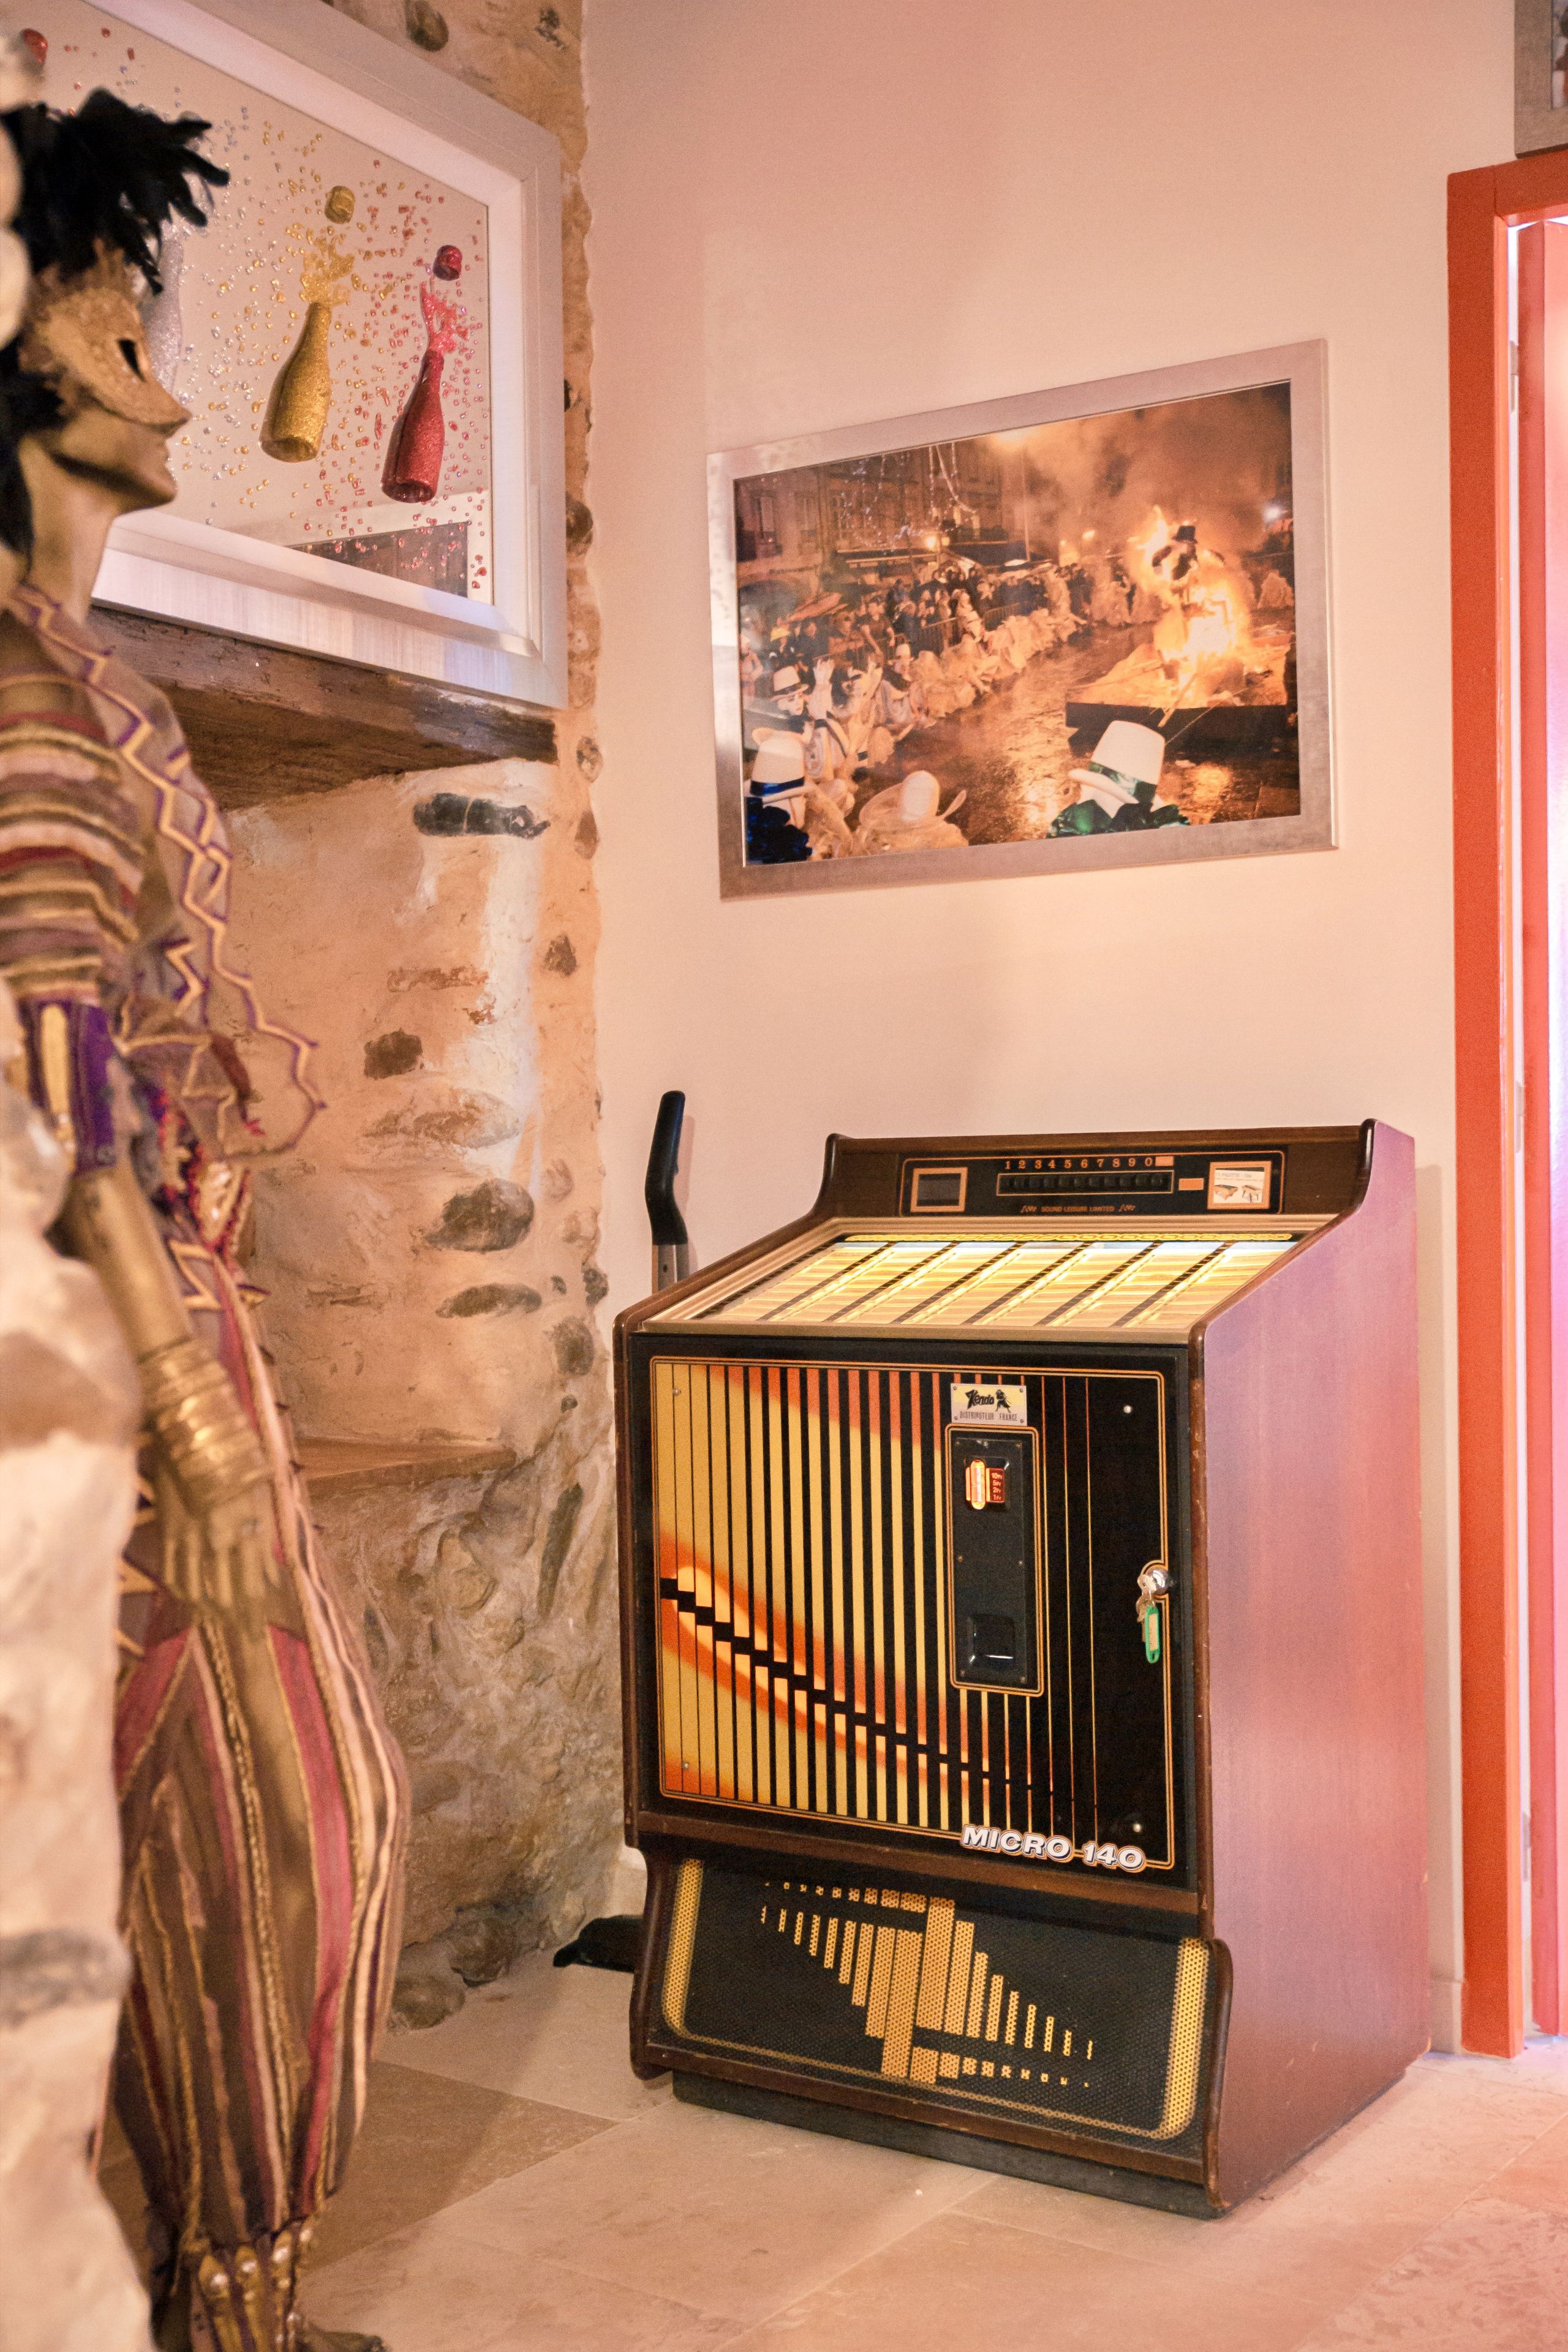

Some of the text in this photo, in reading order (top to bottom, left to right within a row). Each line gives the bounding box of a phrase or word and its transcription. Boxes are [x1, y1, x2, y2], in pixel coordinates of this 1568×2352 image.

[1005, 1157, 1153, 1169] 1 2 3 4 5 6 7 8 9 0
[965, 1389, 995, 1409] Kendo
[960, 1411, 1017, 1421] DISTRIBUTEUR FRANCE
[962, 1824, 1145, 1871] MICRO 140
